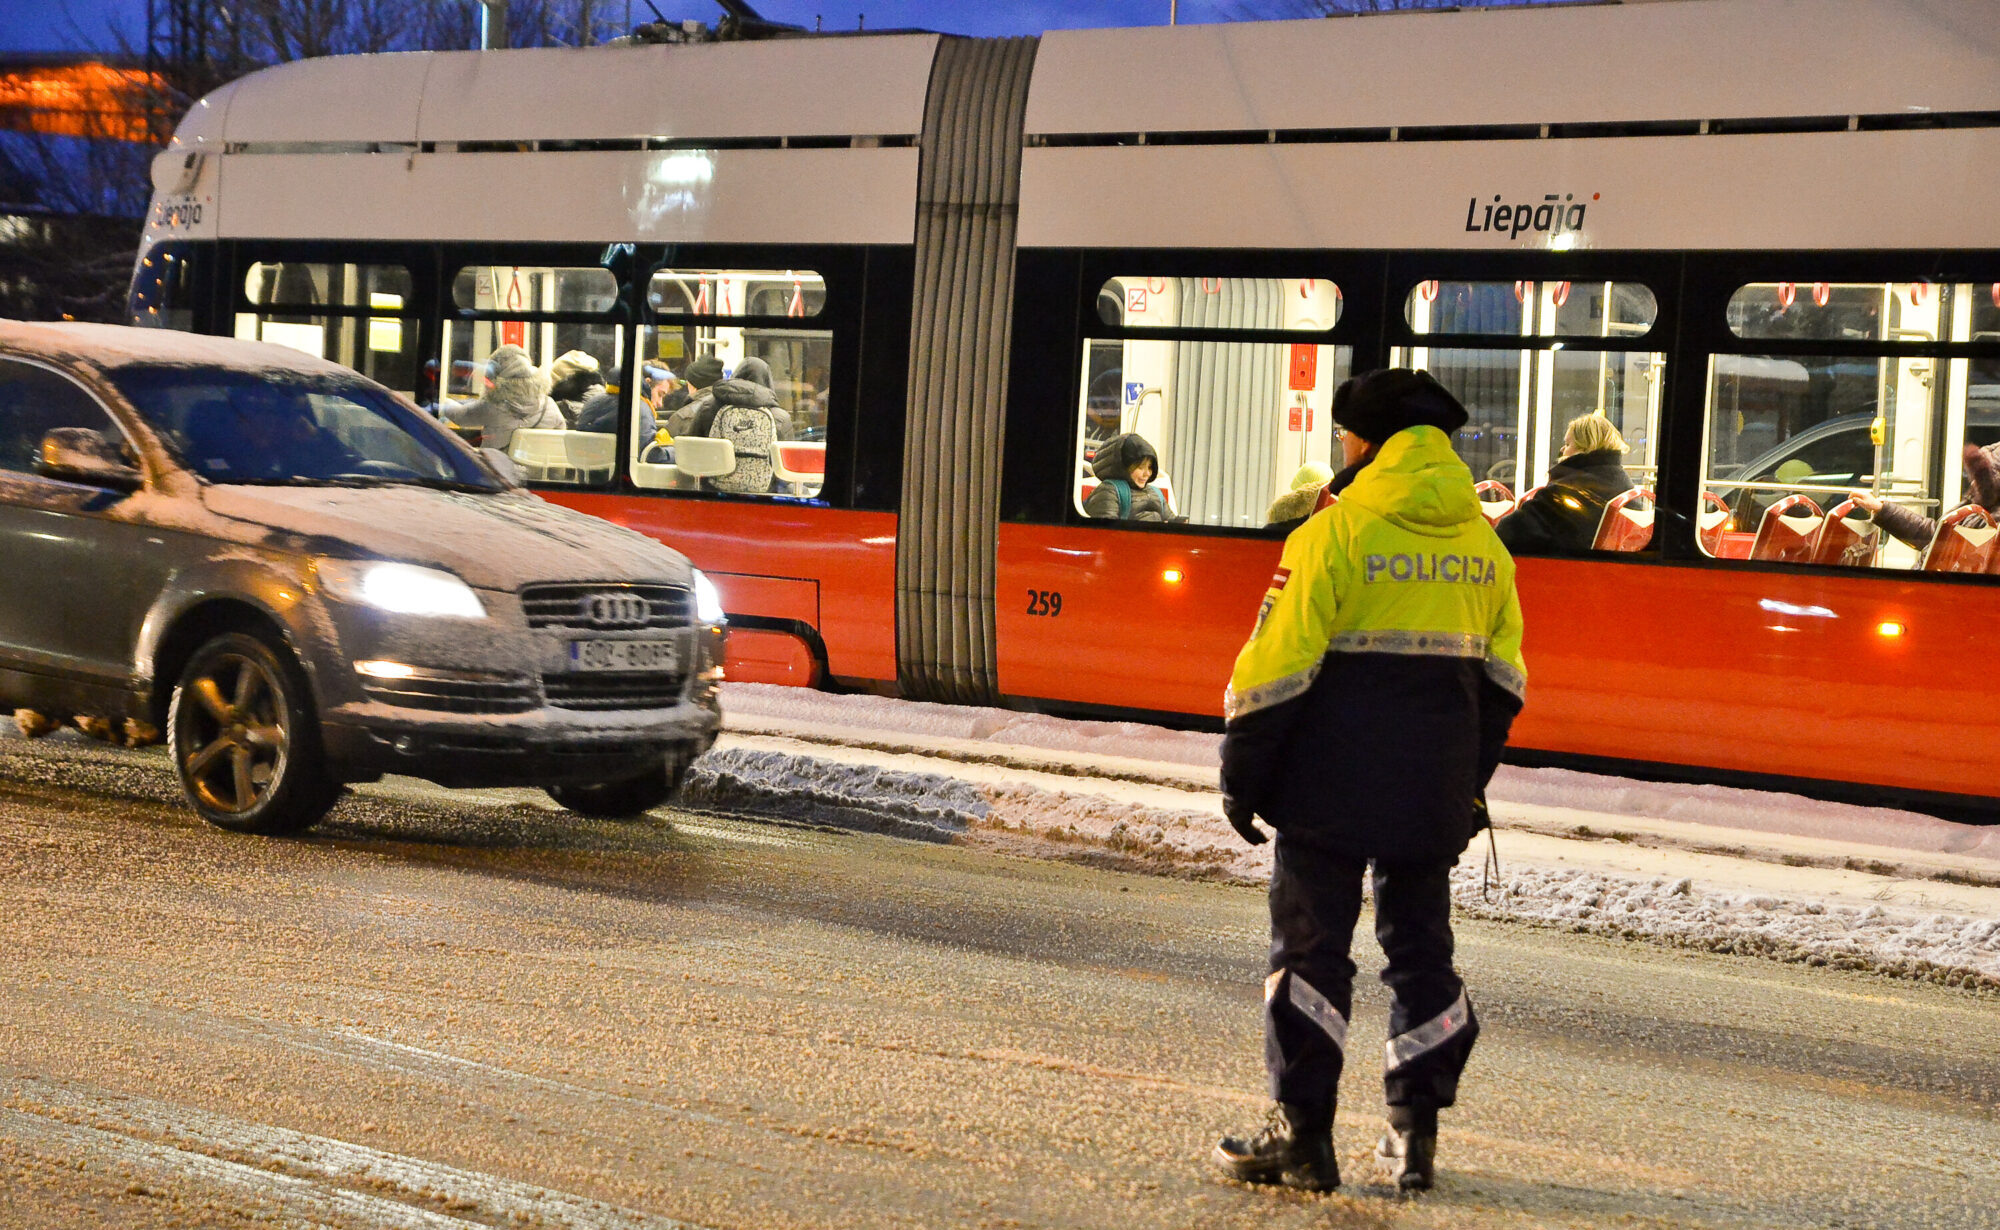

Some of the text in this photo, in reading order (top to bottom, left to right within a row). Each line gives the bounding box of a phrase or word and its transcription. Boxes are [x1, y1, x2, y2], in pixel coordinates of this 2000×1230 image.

[1465, 192, 1587, 240] Liepāja
[1366, 553, 1496, 586] POLICIJA
[1026, 589, 1062, 617] 259
